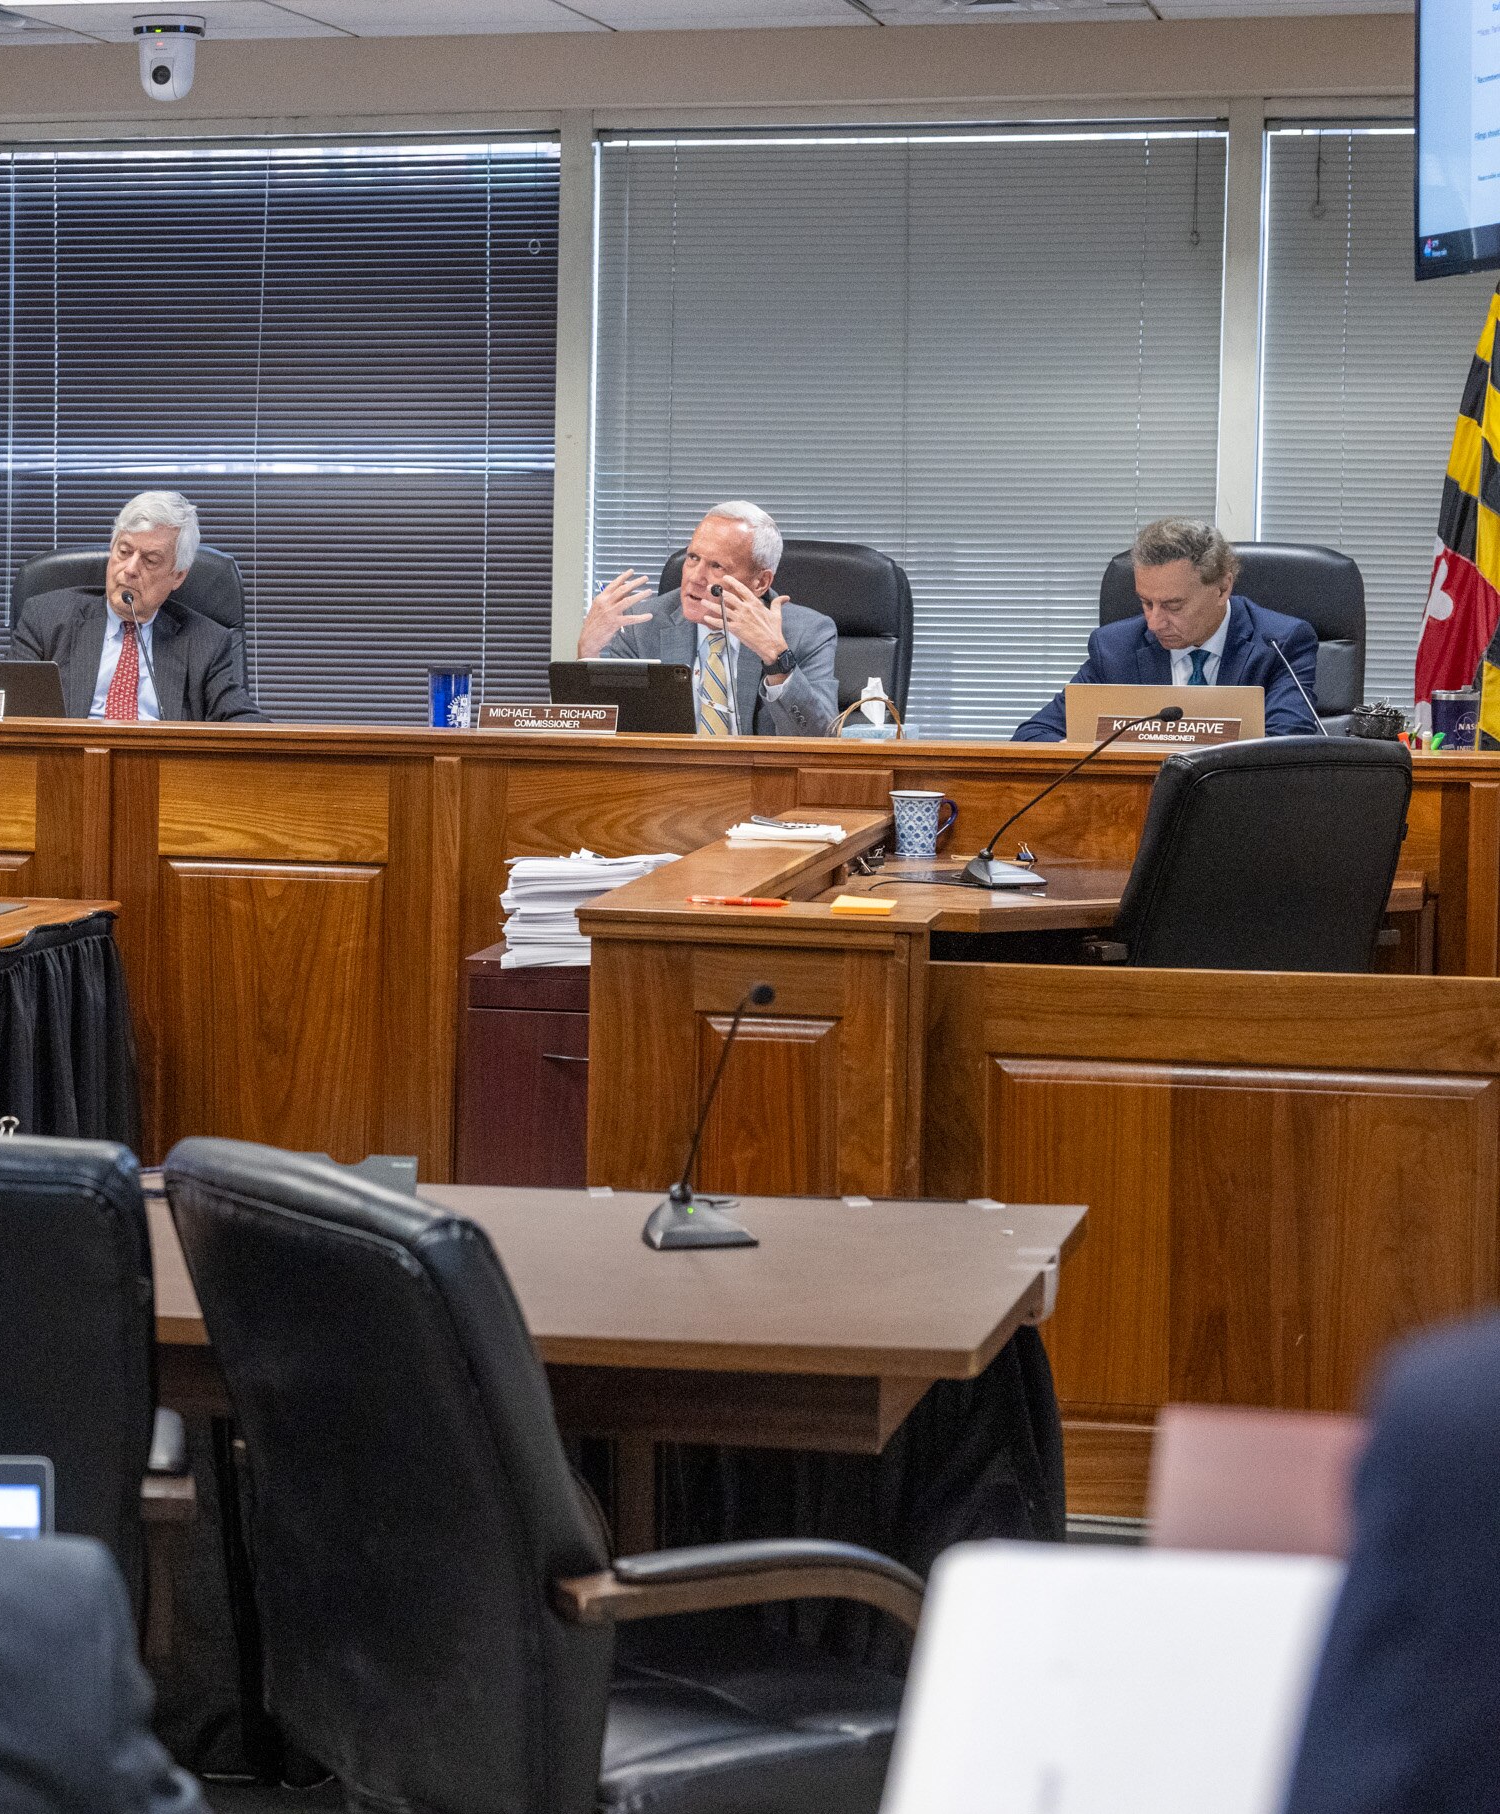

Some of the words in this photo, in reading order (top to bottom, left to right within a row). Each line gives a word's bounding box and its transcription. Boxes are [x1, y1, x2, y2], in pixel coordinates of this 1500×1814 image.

[489, 708, 536, 719] MICHAEL
[543, 708, 554, 719] T.
[559, 709, 607, 720] RICHARD
[514, 719, 580, 729] COMMISSIONER
[1166, 721, 1175, 733] P.
[1177, 722, 1224, 734] BARVE
[1138, 733, 1196, 742] COMMISSIONER
